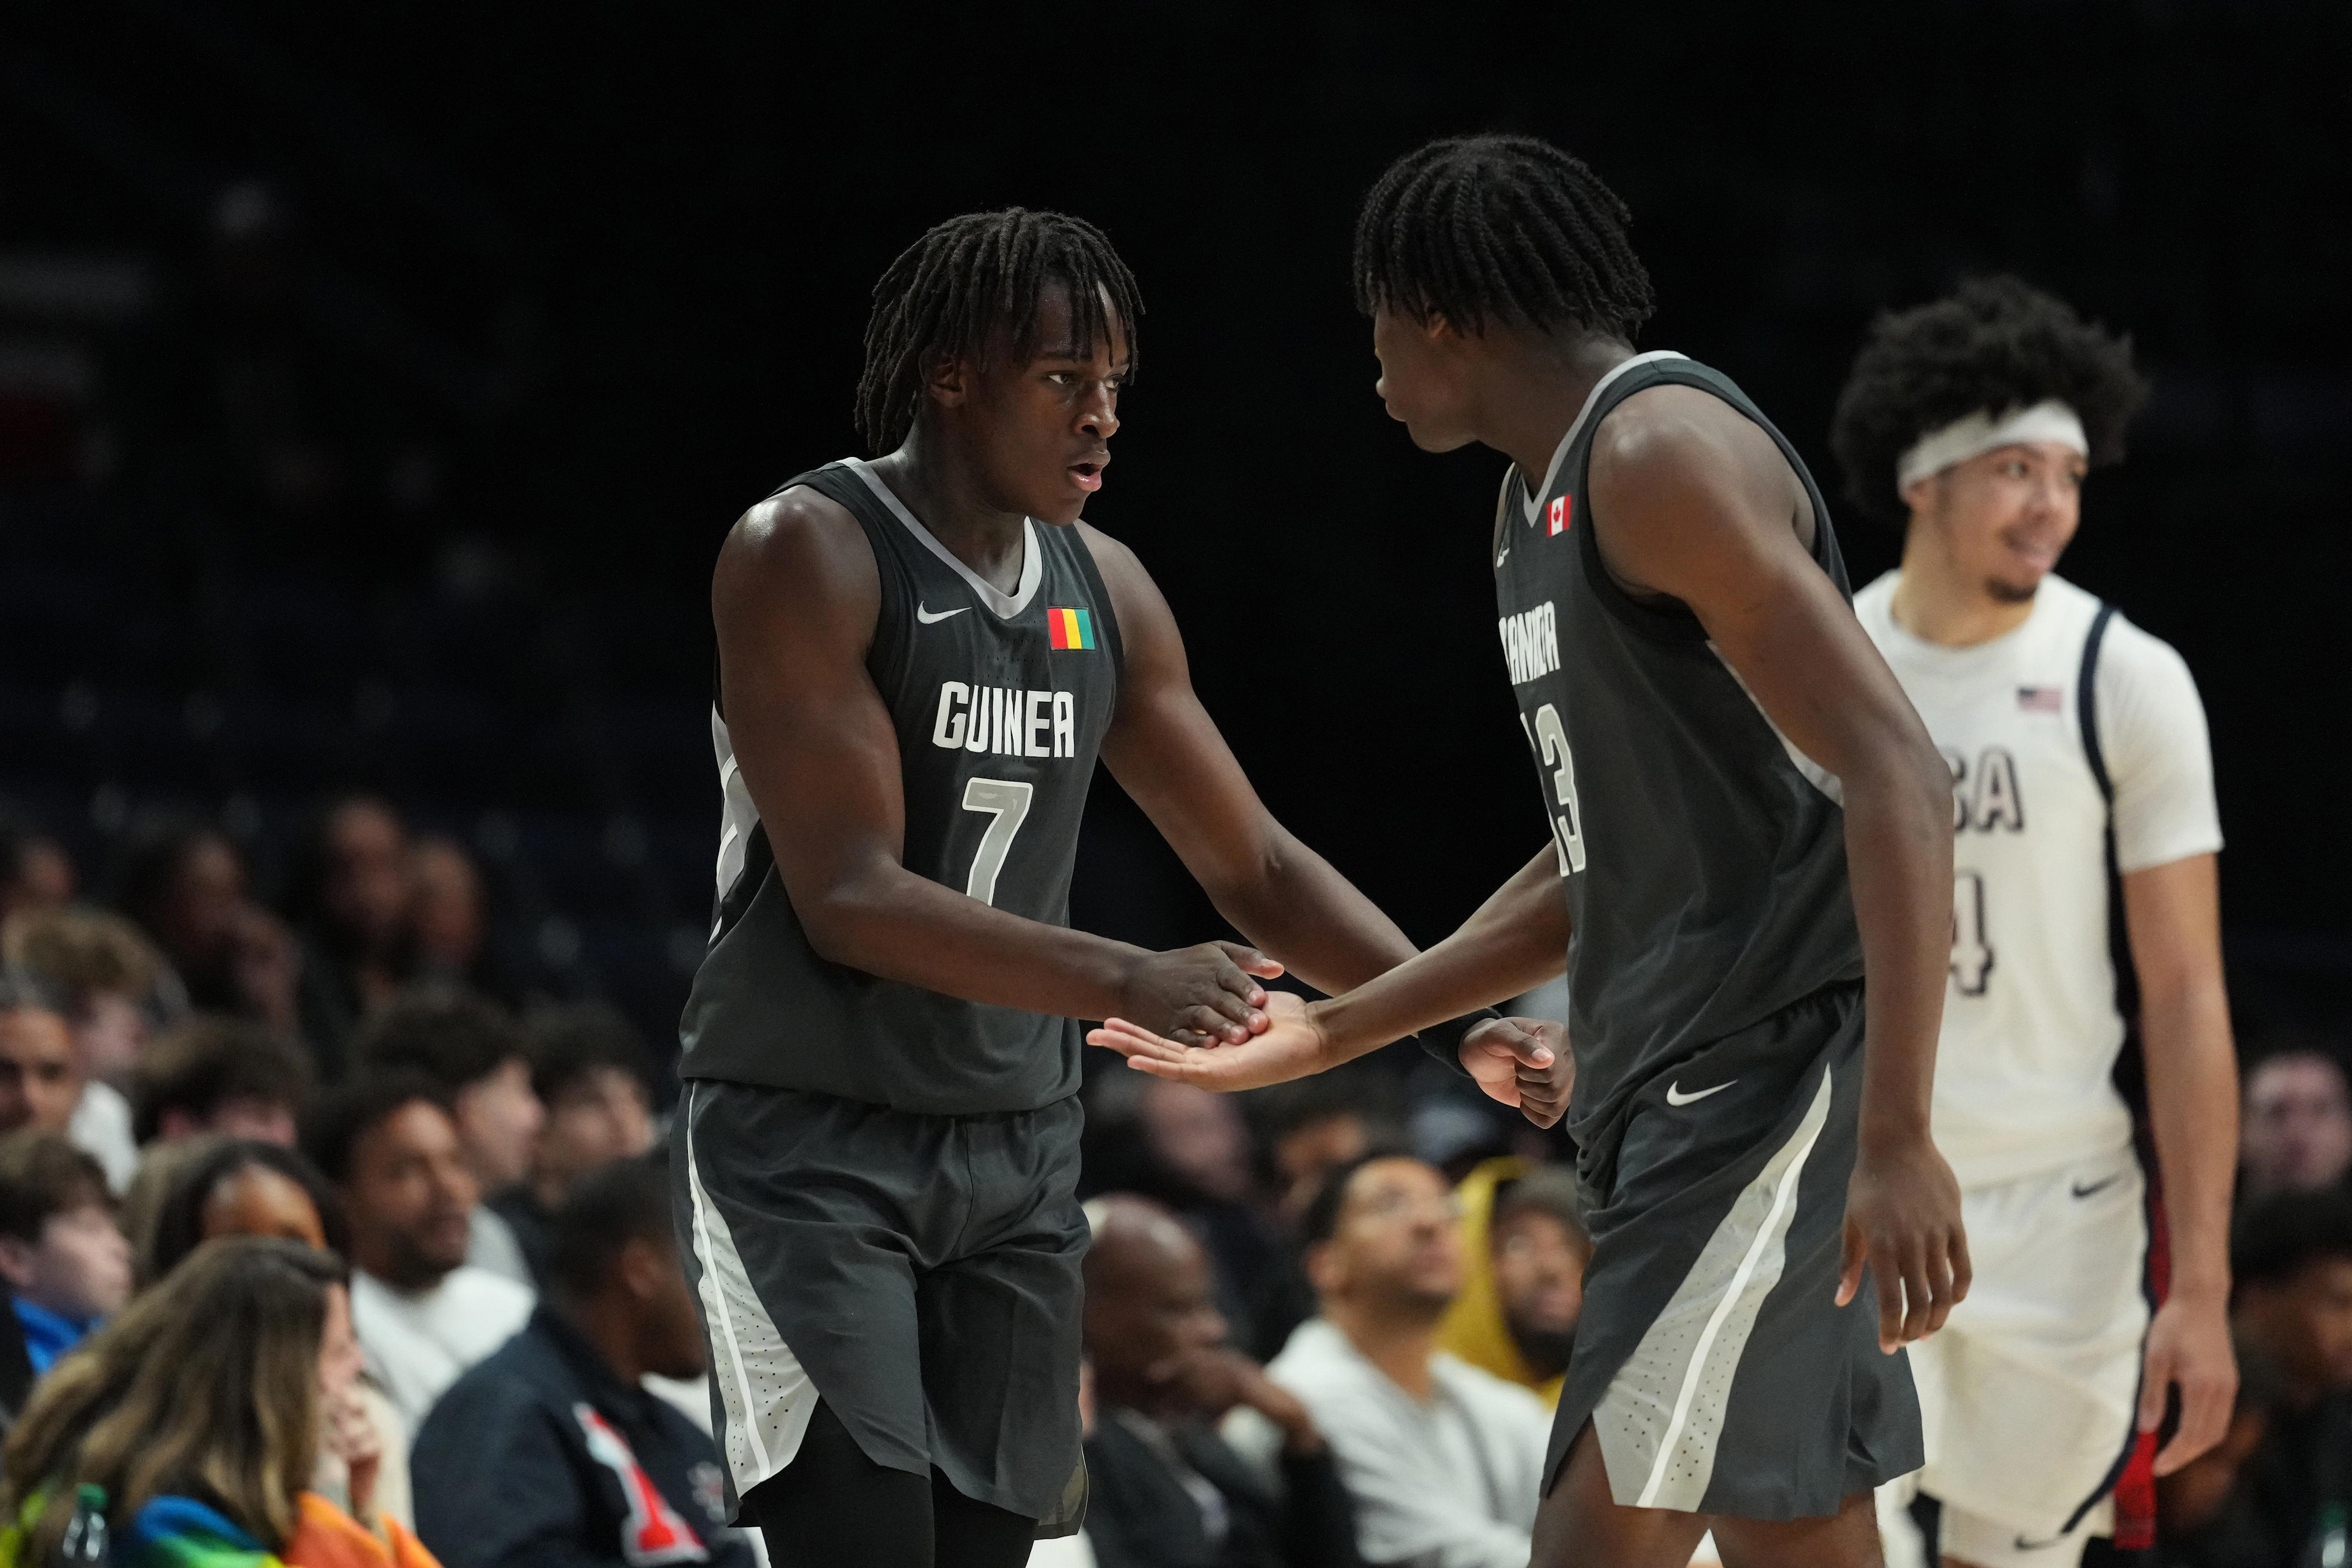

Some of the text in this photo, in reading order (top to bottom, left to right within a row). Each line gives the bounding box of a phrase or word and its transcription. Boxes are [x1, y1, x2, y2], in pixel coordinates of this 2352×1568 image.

[932, 681, 1074, 758] GUINEA
[962, 777, 1033, 906] 7
[1520, 703, 1586, 877] 3
